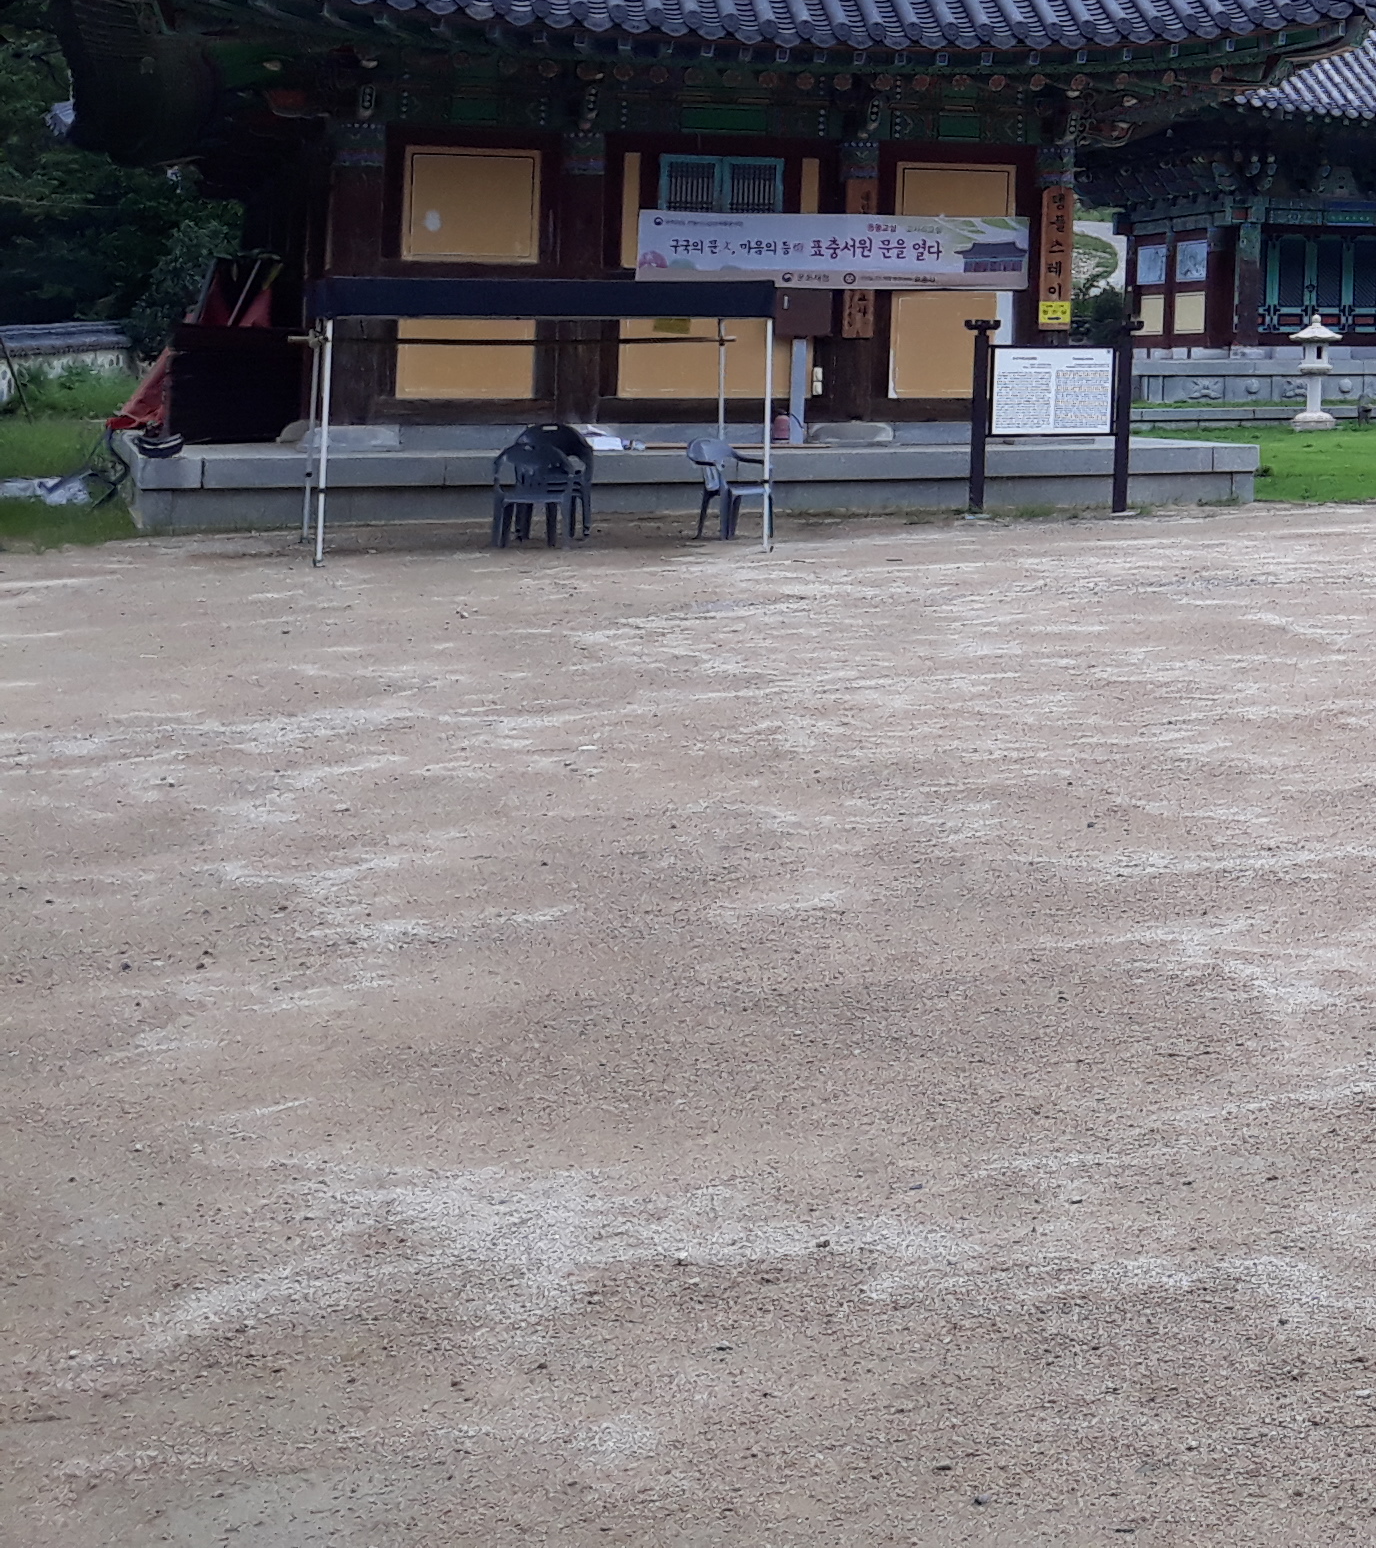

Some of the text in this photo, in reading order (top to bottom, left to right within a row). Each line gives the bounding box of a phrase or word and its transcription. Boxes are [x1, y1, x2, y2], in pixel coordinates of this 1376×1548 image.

[670, 239, 703, 254] 구국의
[739, 239, 777, 255] 마음의
[810, 237, 873, 259] 표충서원
[878, 239, 907, 259] 문을
[912, 239, 943, 261] 열다
